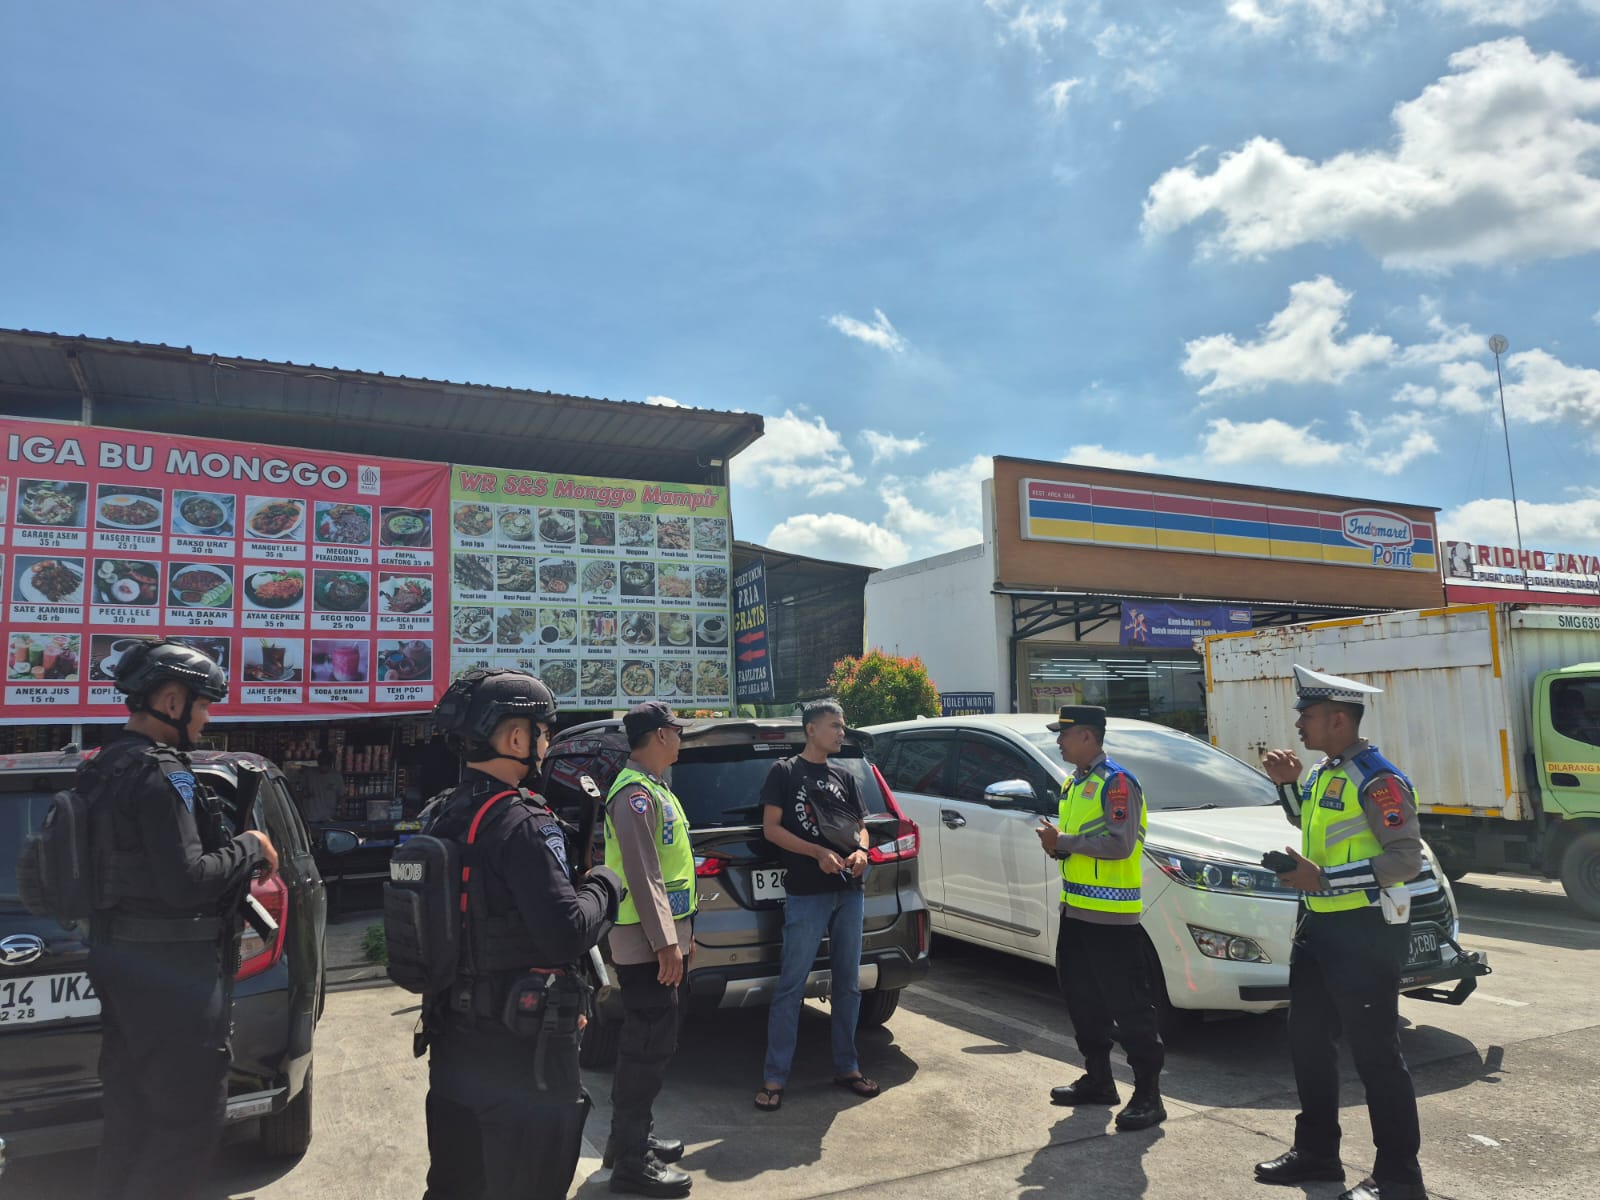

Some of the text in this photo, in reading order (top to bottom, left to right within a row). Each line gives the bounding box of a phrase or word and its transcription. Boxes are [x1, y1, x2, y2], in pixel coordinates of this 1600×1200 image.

[7, 433, 349, 489] IGA BU MONGGO
[460, 471, 497, 493] WR
[553, 479, 636, 508] Monggo
[641, 484, 719, 511] Mampir
[1347, 518, 1409, 540] Indomaret
[21, 530, 78, 540] GARANG ASEM
[100, 534, 156, 544] NASGOR TELUR
[39, 538, 60, 547] 35 rb
[130, 542, 138, 550] rb
[177, 539, 228, 549] BAKSO URAT
[204, 546, 213, 554] rb
[281, 544, 298, 552] LELE
[326, 548, 359, 556] MEGONO
[315, 555, 353, 563] PEKALONGAN
[1372, 543, 1412, 569] Point
[1477, 545, 1600, 574] RIDHO JAYA
[381, 557, 412, 566] GENTONG
[1506, 574, 1525, 585] OLEH
[1535, 576, 1553, 586] OLEH
[1556, 577, 1576, 588] KHAS
[738, 584, 760, 608] PRIA
[14, 605, 80, 615] SATE KAMBING
[99, 608, 151, 617] PECEL LELE
[172, 610, 193, 618] NILA
[36, 614, 60, 622] 45 rb
[127, 616, 136, 624] rb
[246, 613, 300, 621] AYAM GEPREK
[320, 614, 342, 622] SEGO
[203, 618, 214, 626] rb
[276, 620, 284, 628] rb
[15, 687, 70, 695] ANEKA JUS
[91, 687, 111, 695] KOPI
[112, 695, 122, 703] 15
[943, 697, 965, 707] TOILET
[1548, 763, 1594, 772] DILARANG
[756, 872, 765, 889] B
